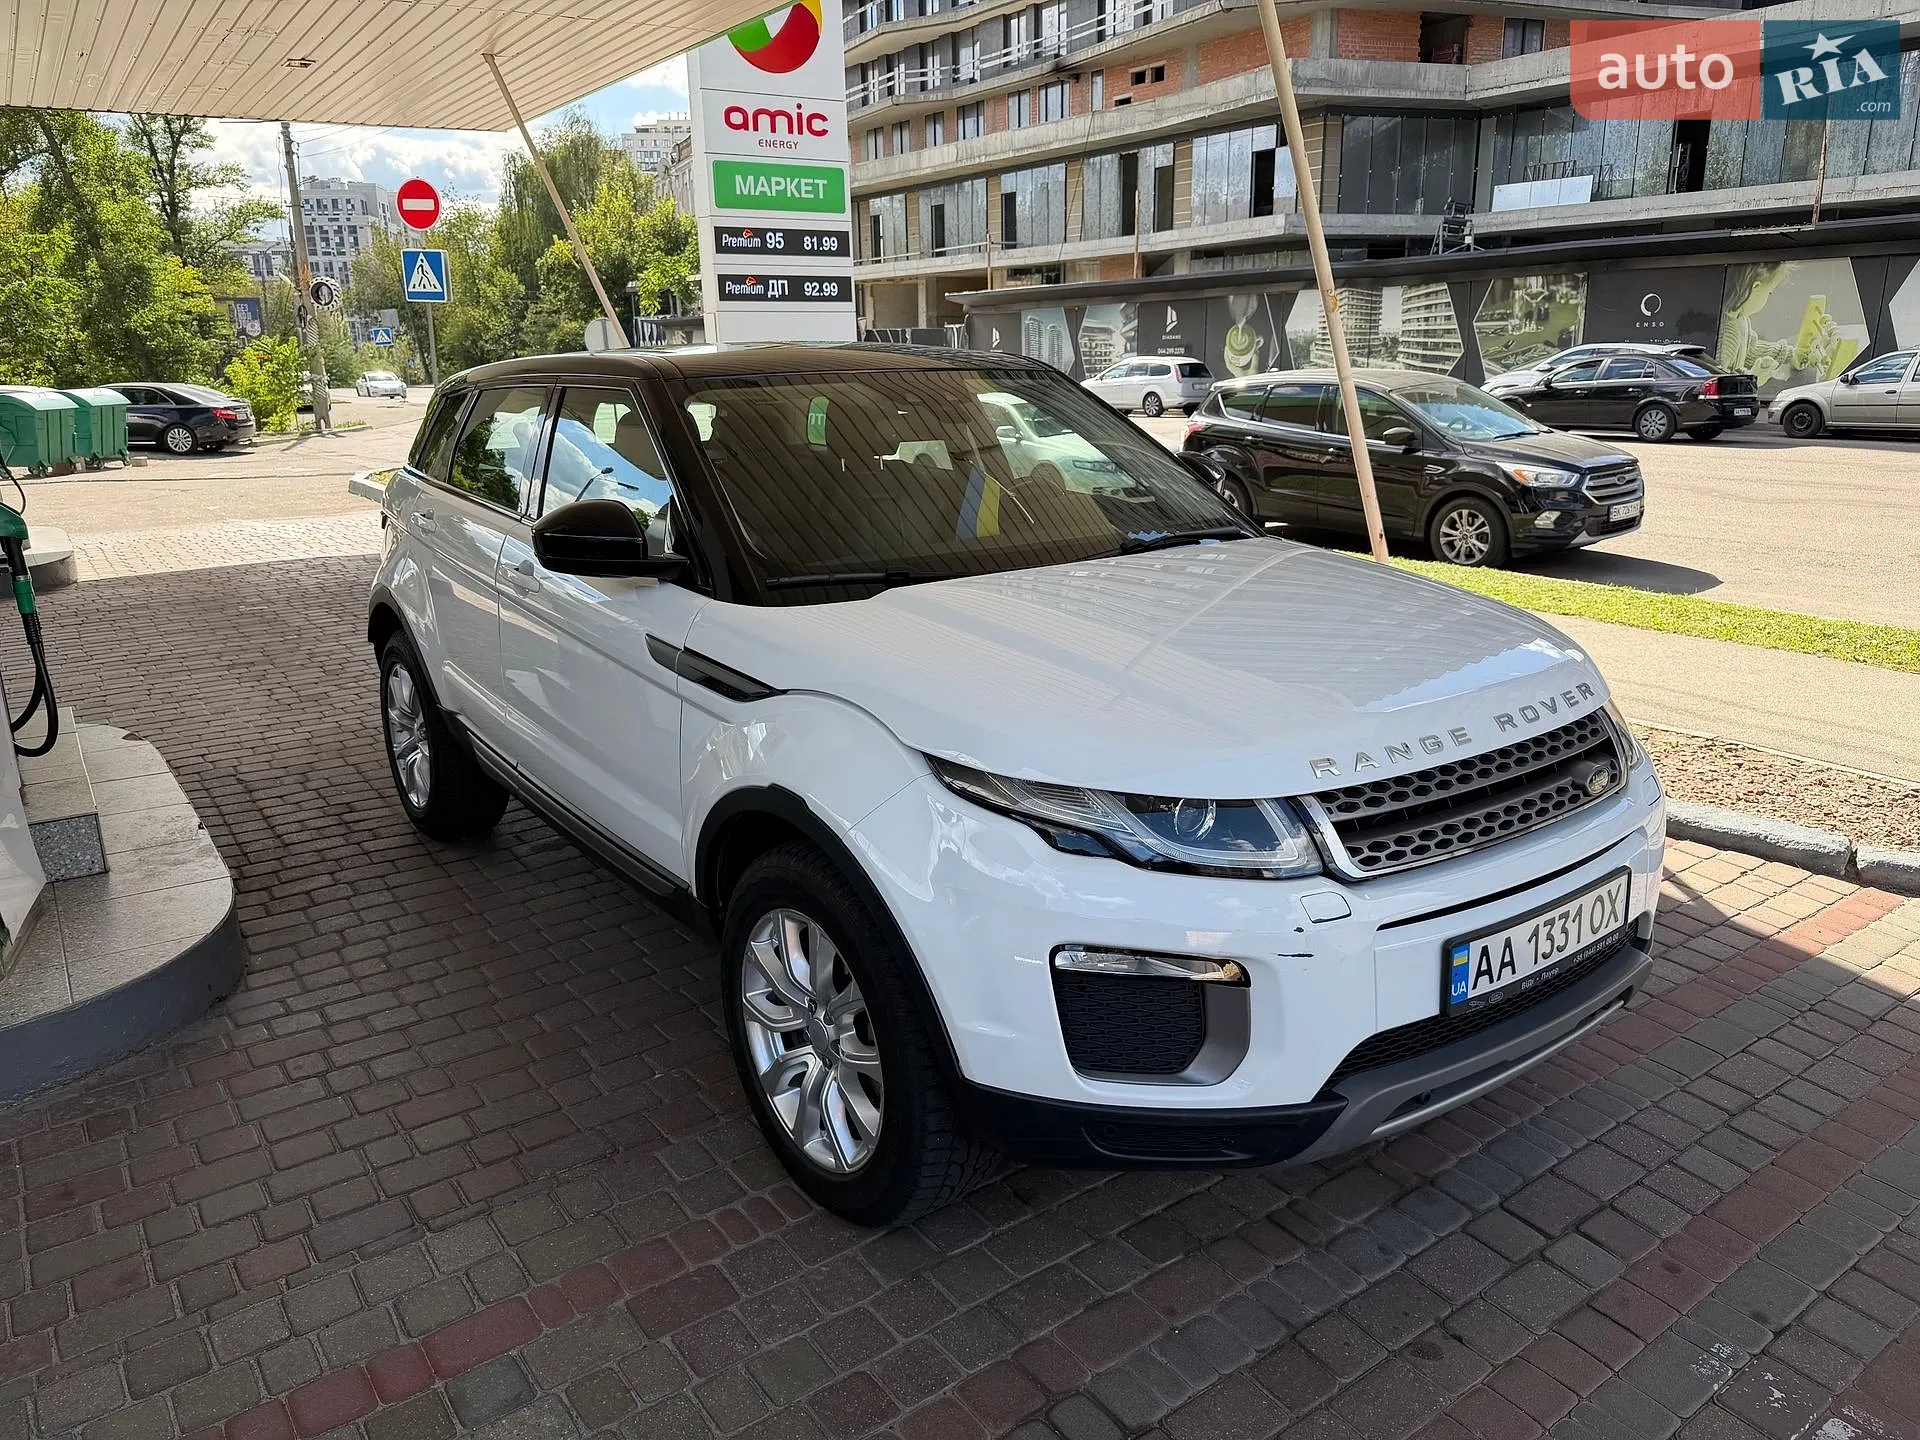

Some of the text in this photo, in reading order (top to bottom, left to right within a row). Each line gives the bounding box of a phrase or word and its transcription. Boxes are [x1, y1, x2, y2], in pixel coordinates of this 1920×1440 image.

[723, 102, 829, 138] amic
[758, 138, 800, 150] ENERGY
[735, 174, 827, 199] МАРКЕТ
[722, 232, 838, 251] Premium 95 81.99
[725, 280, 839, 298] Premium ДП 92.99
[1308, 680, 1596, 780] RANGE ROVER
[1471, 883, 1622, 991] AA 1331 OX
[1451, 979, 1467, 997] UA
